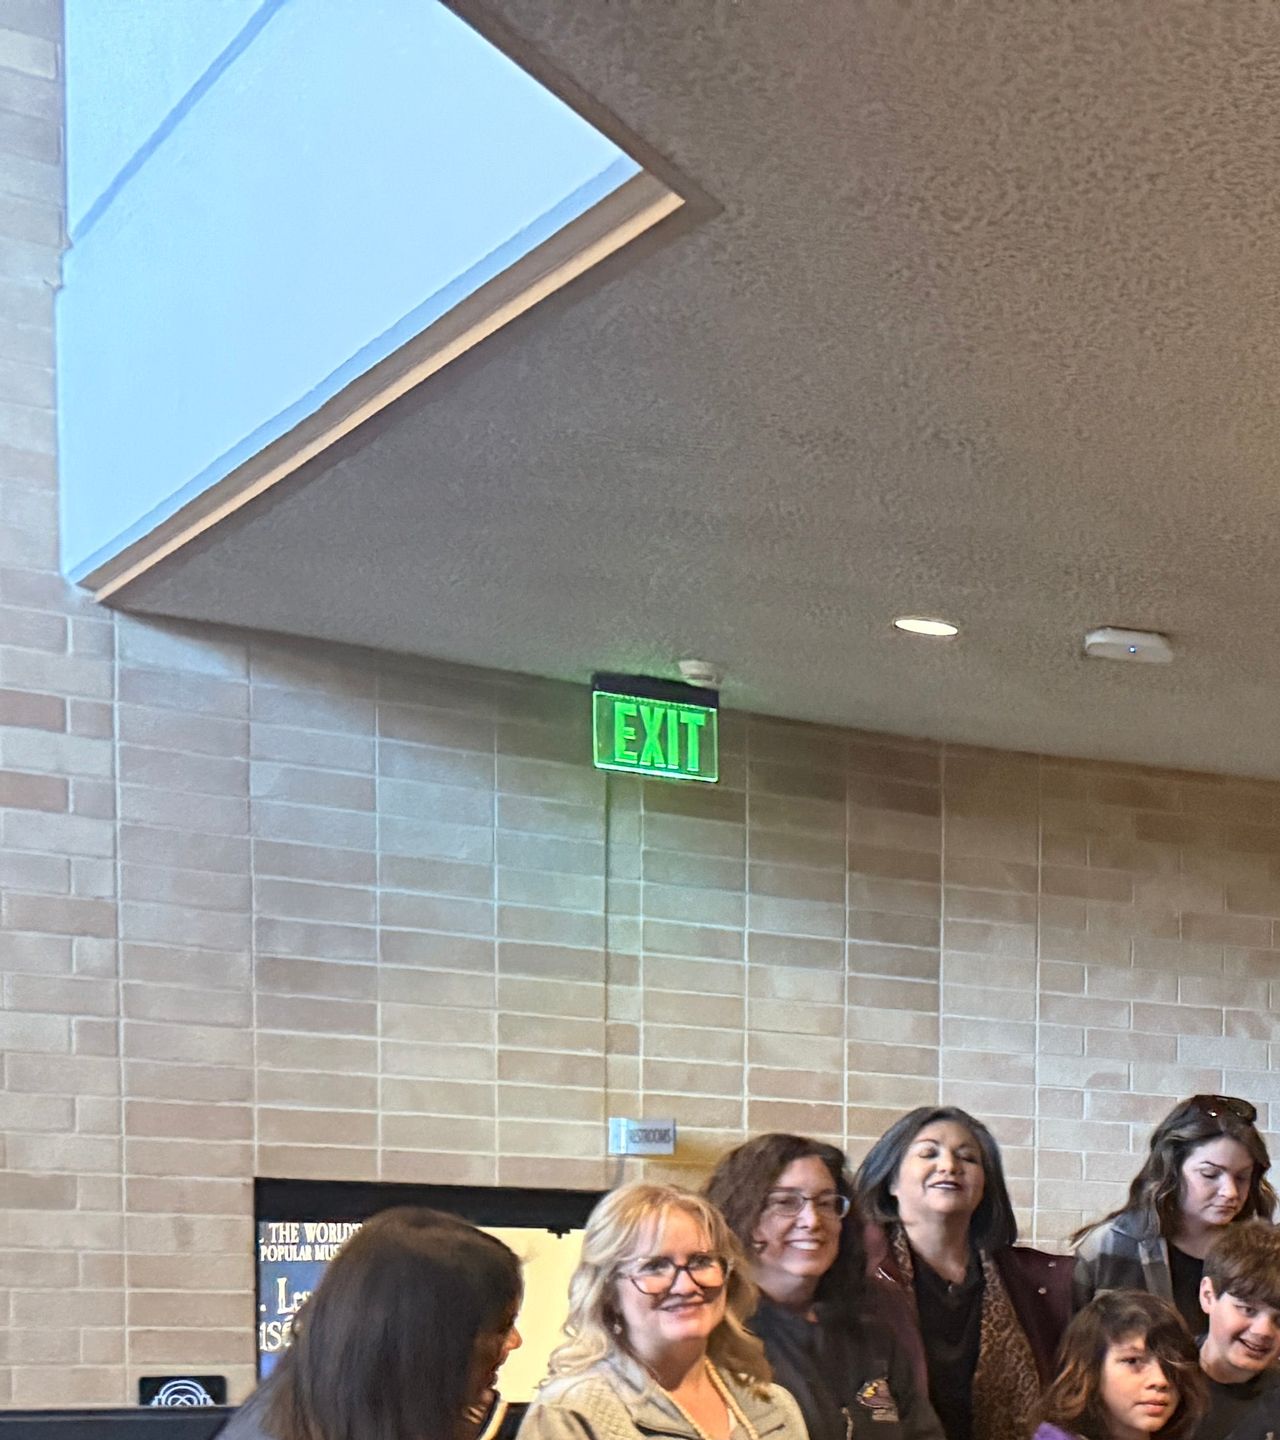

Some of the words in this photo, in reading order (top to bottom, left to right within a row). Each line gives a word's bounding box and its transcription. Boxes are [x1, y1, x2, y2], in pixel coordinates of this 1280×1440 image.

[614, 701, 705, 772] EXIT
[268, 1222, 300, 1244] THE
[260, 1244, 313, 1262] POPULAR
